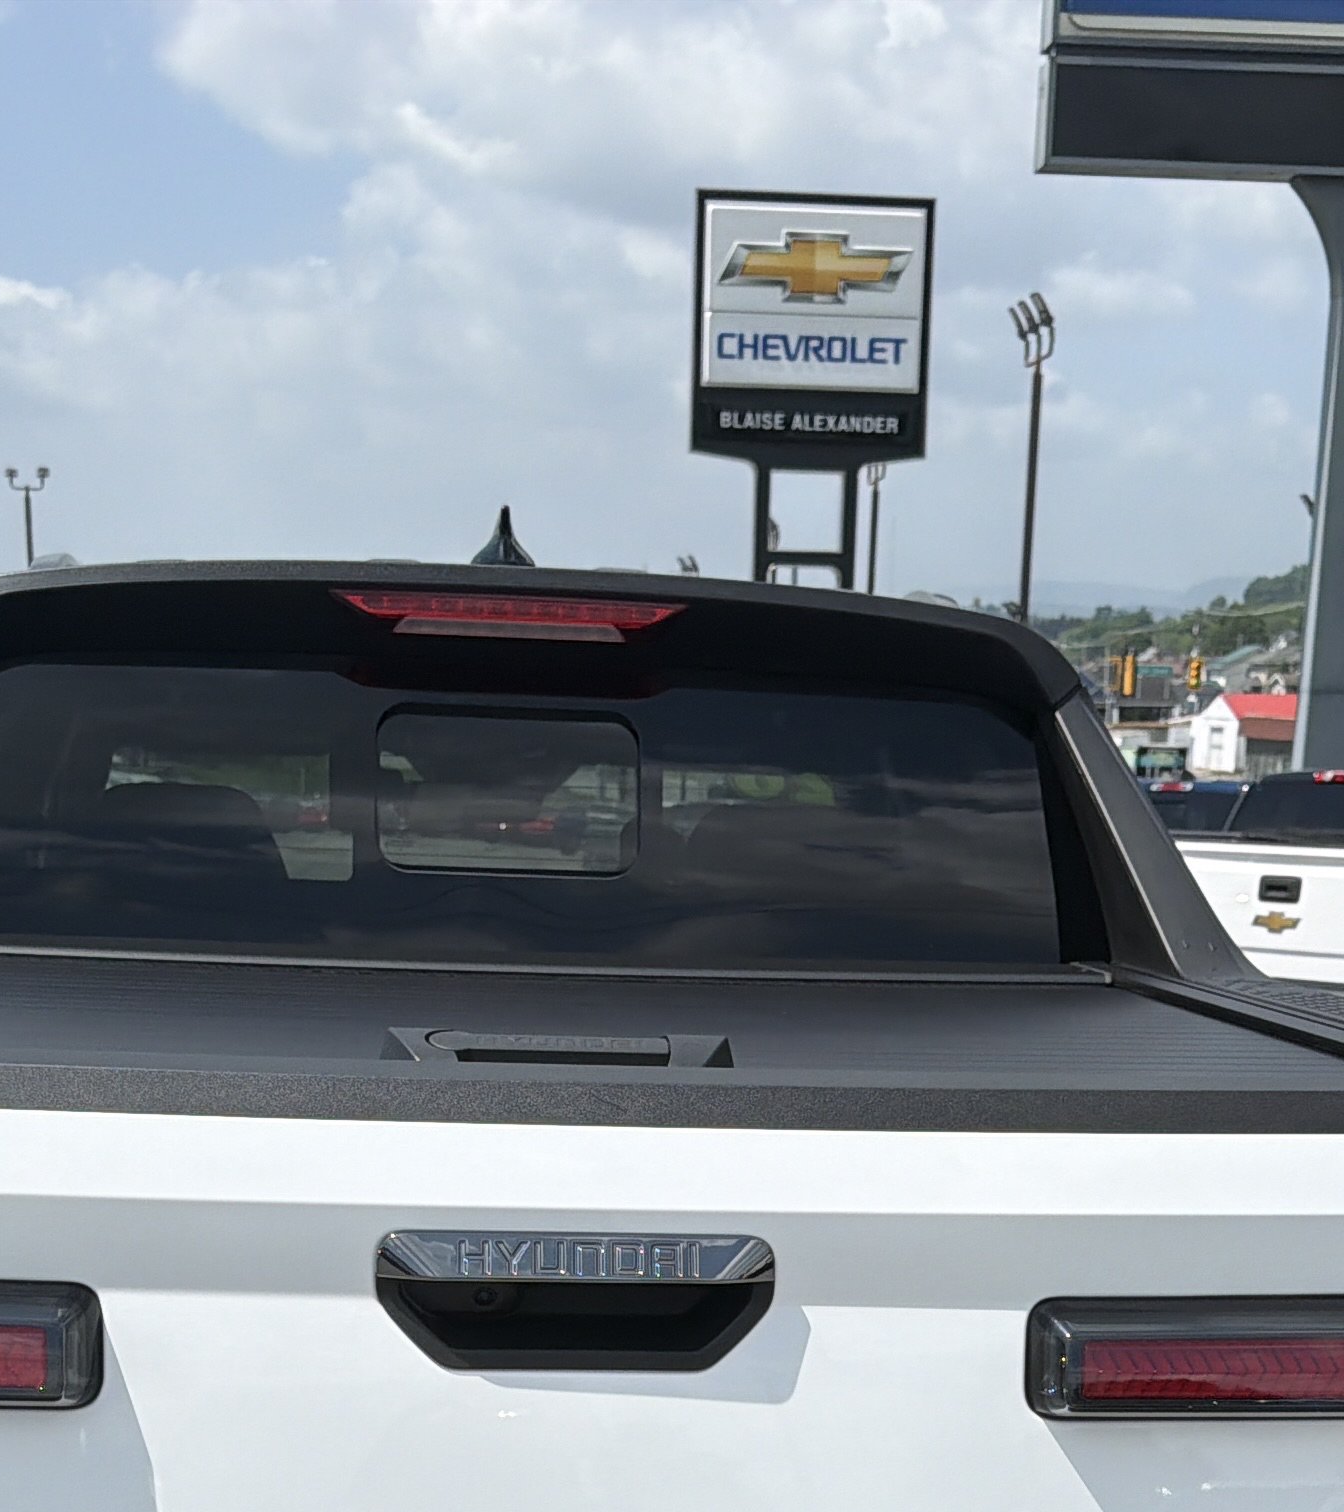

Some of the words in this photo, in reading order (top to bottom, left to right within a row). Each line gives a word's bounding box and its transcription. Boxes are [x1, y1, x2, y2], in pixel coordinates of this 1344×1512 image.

[717, 332, 908, 365] CHEVROLET
[719, 410, 785, 431] BLAISE
[790, 411, 899, 434] ALEXANDER
[458, 1238, 701, 1278] HYUNDAI
